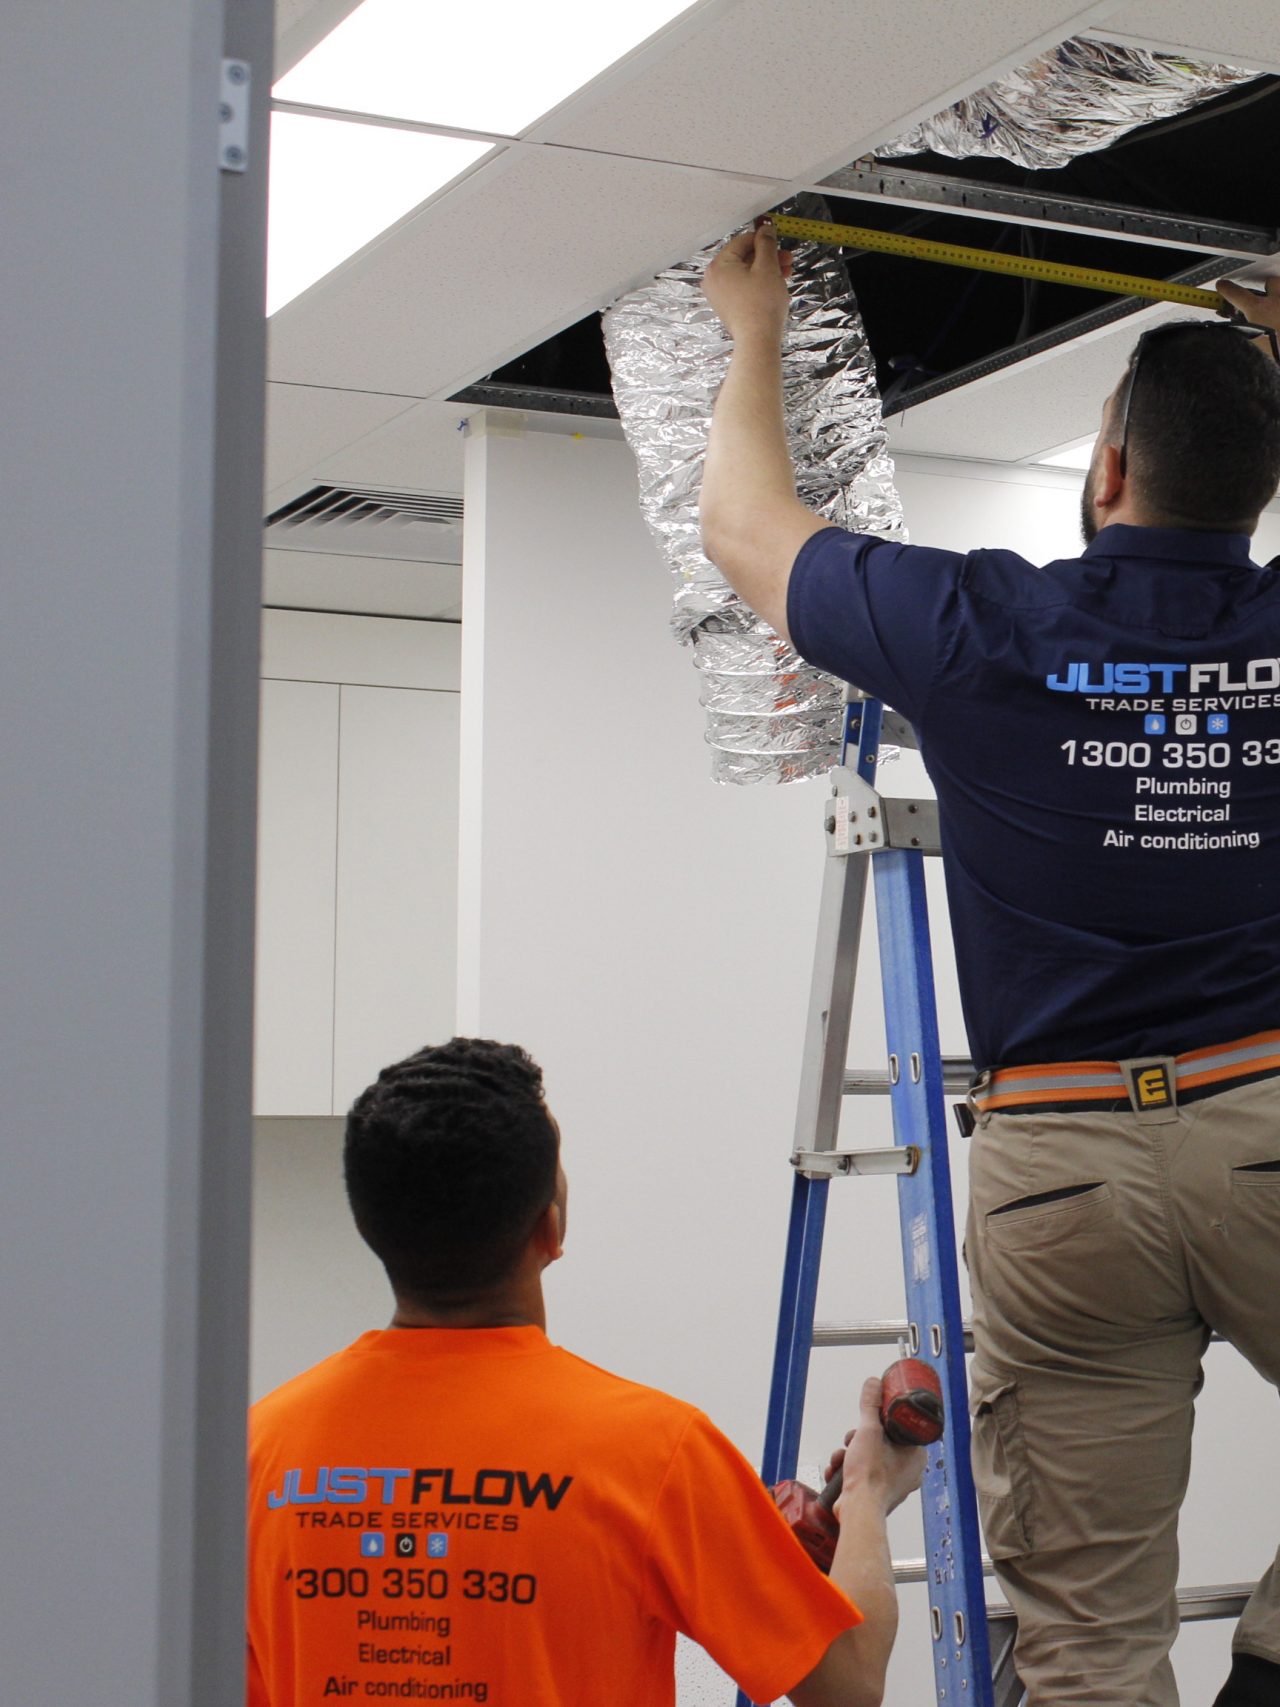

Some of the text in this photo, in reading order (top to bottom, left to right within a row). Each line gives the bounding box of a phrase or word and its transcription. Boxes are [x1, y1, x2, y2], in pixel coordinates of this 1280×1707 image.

[1086, 698, 1165, 712] TRADE
[1060, 739, 1152, 768] 1300
[1162, 741, 1232, 769] 350
[1135, 776, 1232, 798] Plumbing
[1134, 804, 1230, 823] Electrical
[1103, 829, 1261, 850] Air conditioning
[296, 1511, 520, 1532] TRADE SERVICES
[284, 1568, 538, 1605] 300 350 330
[357, 1610, 451, 1637] Plumbing
[358, 1643, 451, 1666] Electrical
[323, 1676, 489, 1703] Air conditioning
